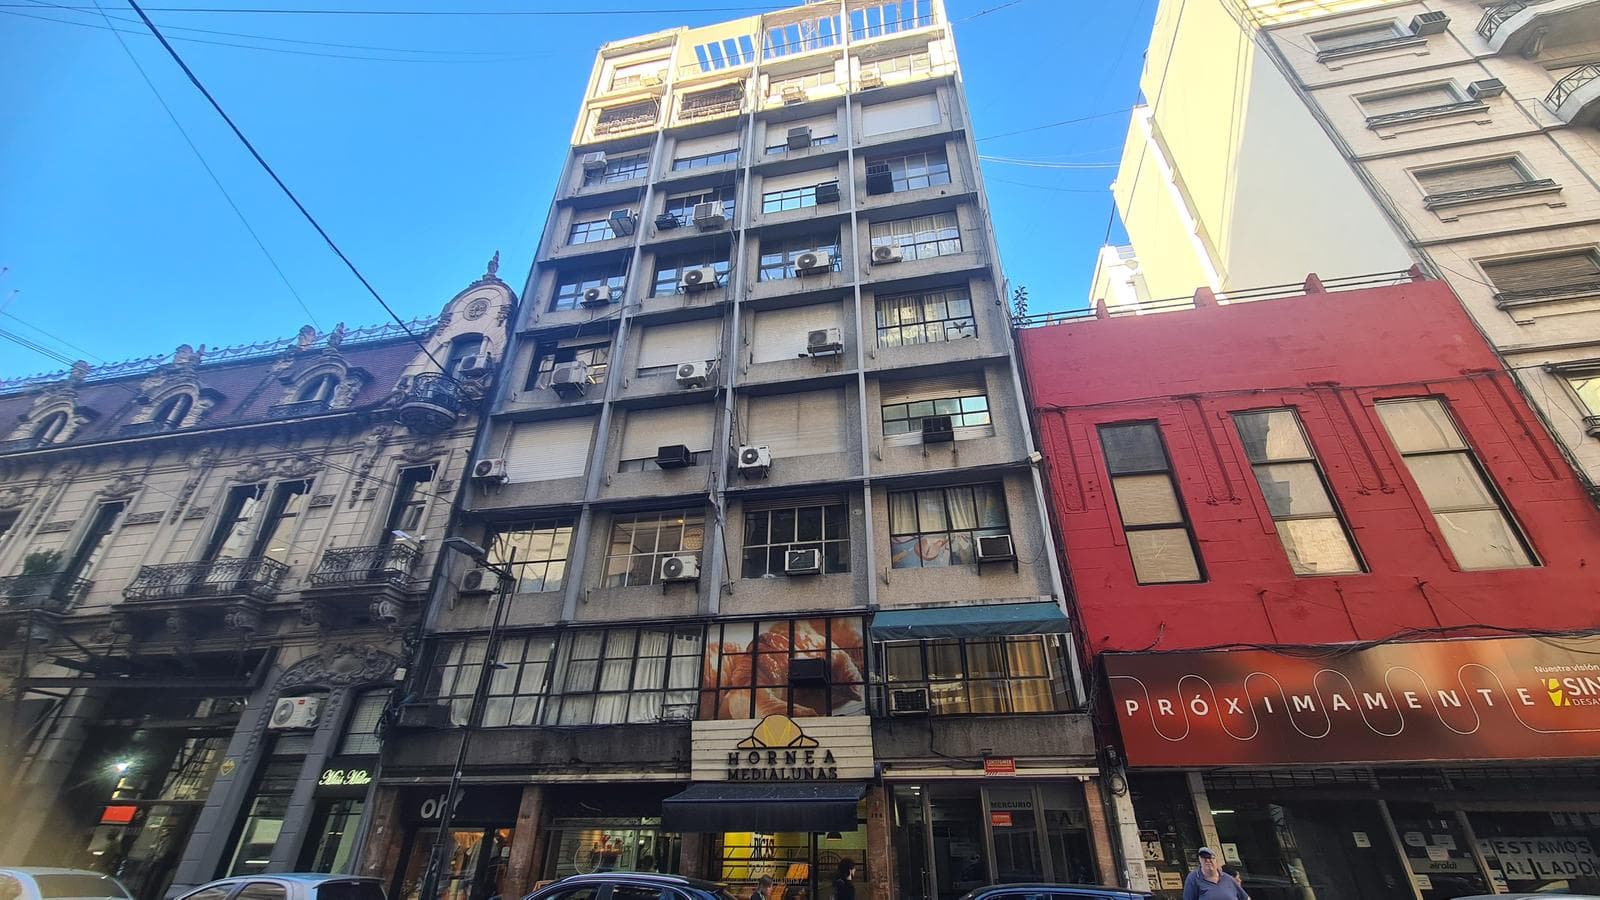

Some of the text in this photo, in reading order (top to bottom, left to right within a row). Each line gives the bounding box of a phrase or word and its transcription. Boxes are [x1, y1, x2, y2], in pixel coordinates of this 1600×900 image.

[1534, 663, 1600, 673] Nuestra visión
[1125, 687, 1535, 716] PRÓXIMAMENTE
[728, 749, 836, 765] HORNEA
[728, 767, 838, 780] MEDIALUNAS
[1494, 840, 1592, 854] ESTAMOS
[1506, 861, 1593, 875] AL LADO
